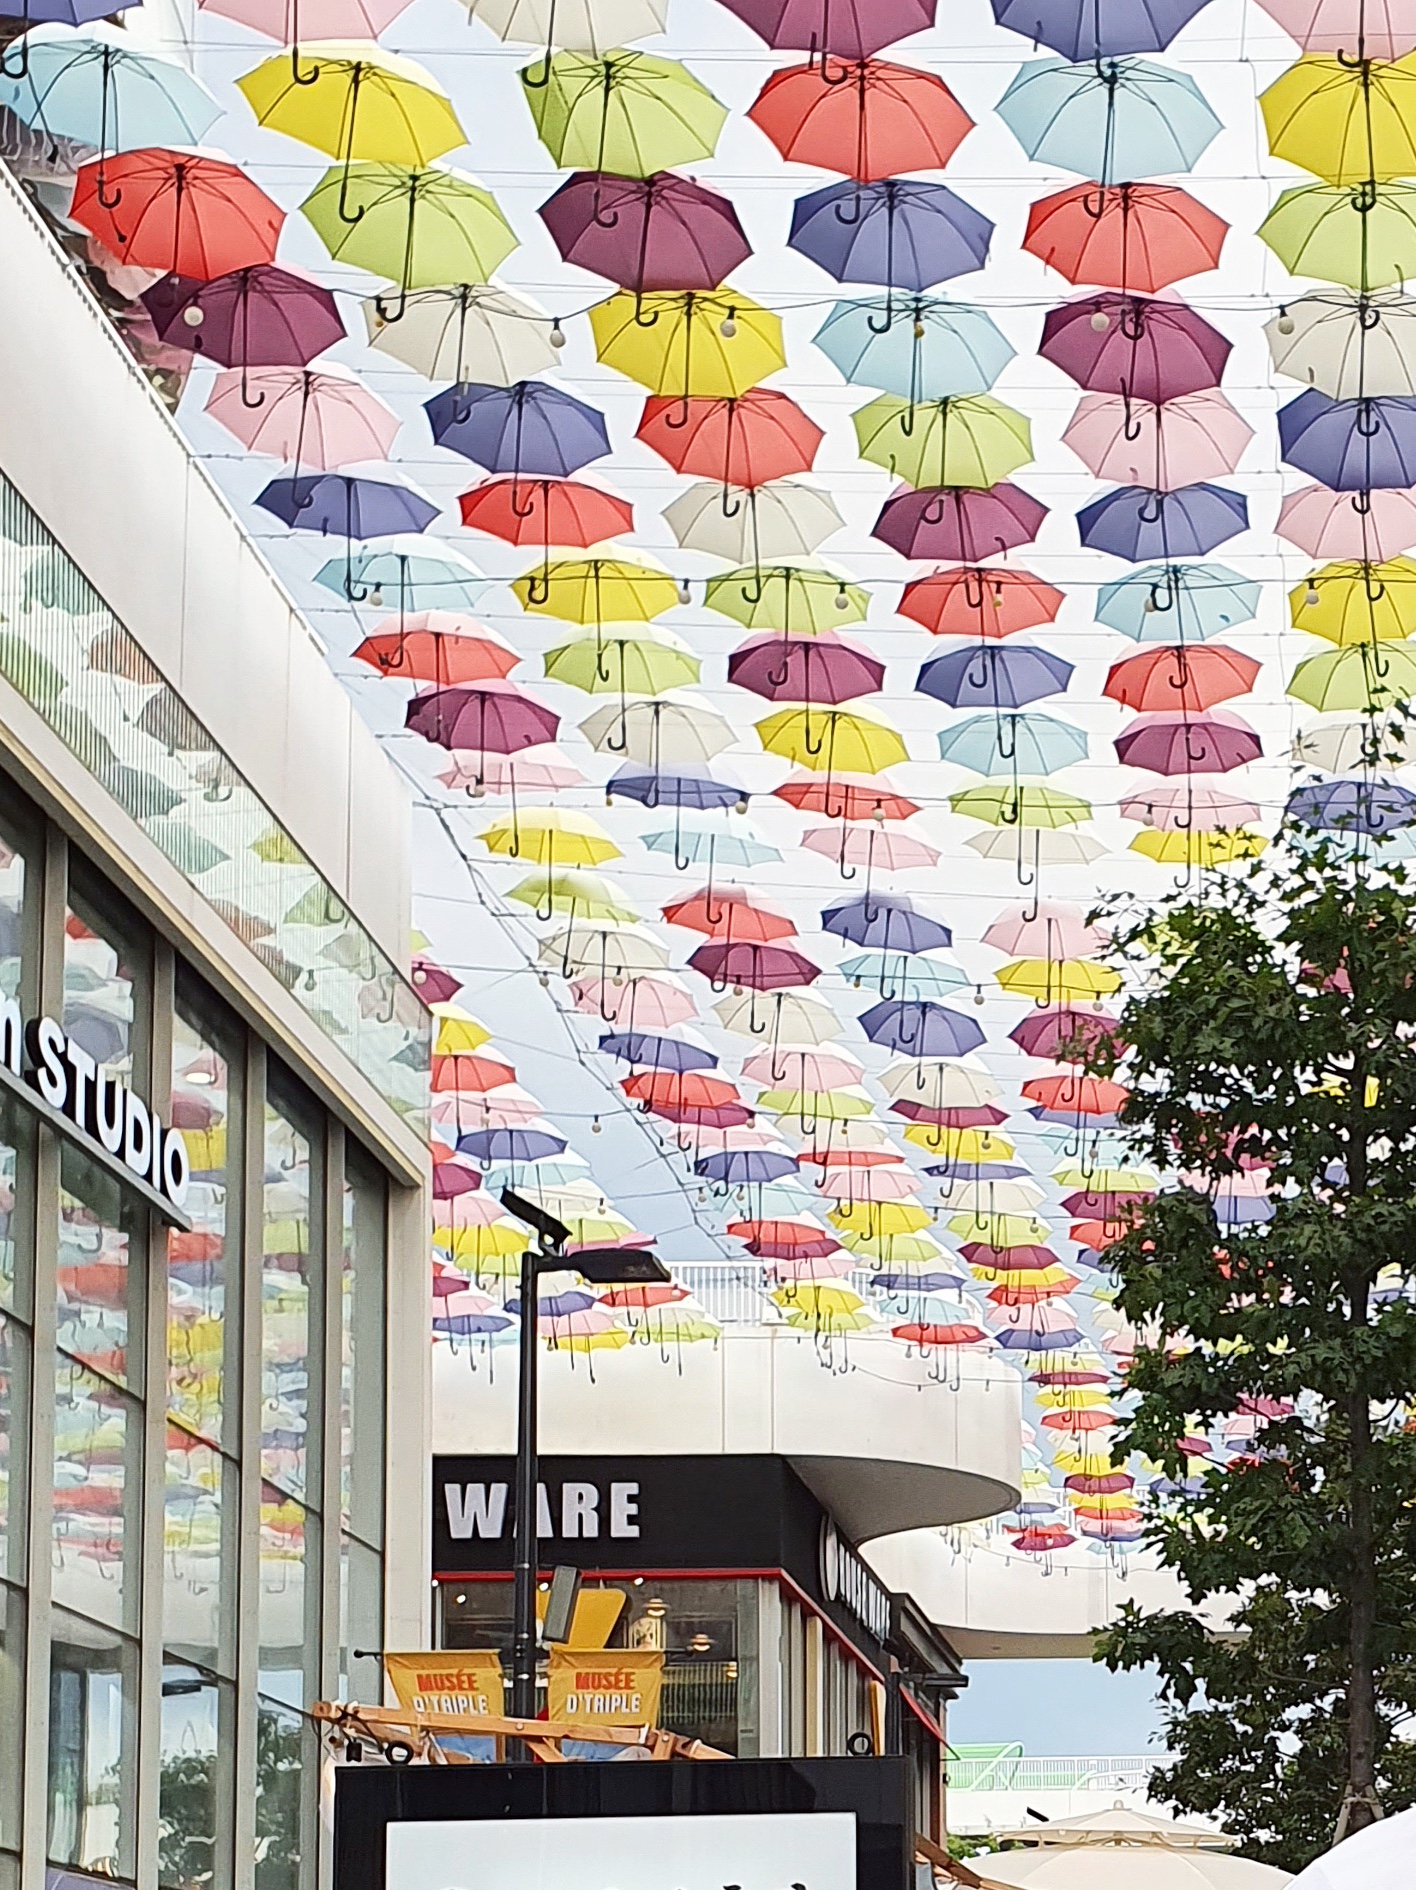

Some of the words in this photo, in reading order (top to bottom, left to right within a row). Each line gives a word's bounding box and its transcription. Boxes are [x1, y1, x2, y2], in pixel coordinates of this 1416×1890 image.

[37, 1016, 190, 1207] STUDIO
[416, 1668, 480, 1692] MUSÉE
[574, 1666, 636, 1691] MUSÉE
[565, 1692, 641, 1714] D'TRIPLE
